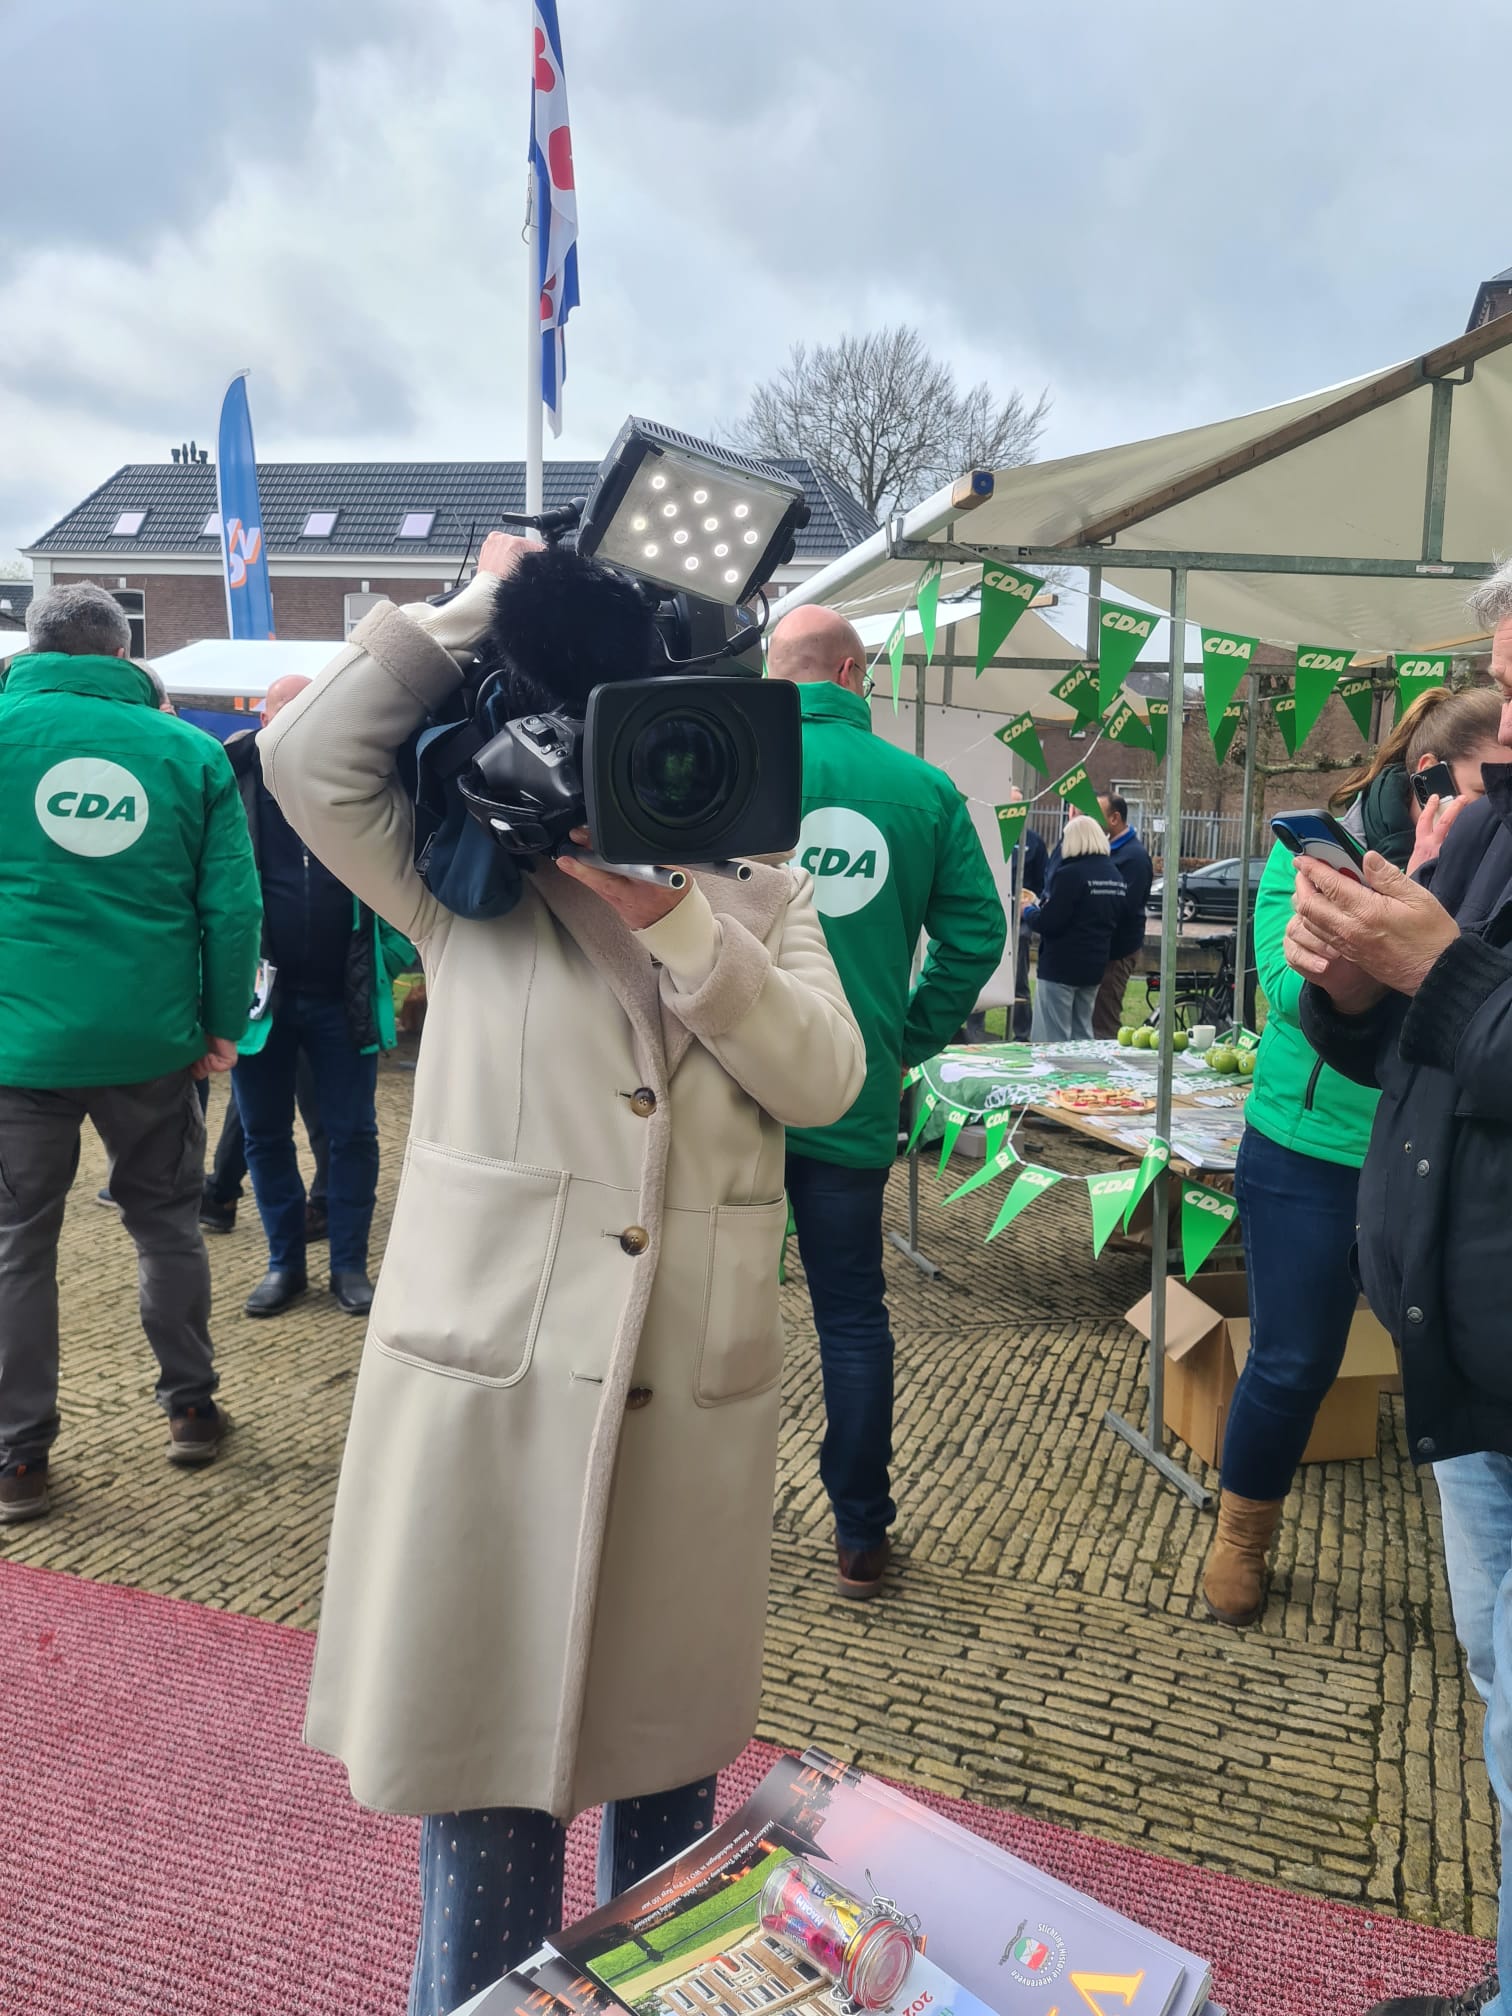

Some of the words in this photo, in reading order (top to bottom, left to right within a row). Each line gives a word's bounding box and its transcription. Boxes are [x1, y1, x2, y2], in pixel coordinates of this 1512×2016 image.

[984, 571, 1034, 601] CDA
[1102, 611, 1151, 638] CDA
[1203, 637, 1251, 659] CDA
[1298, 653, 1347, 672] CDA
[1400, 661, 1445, 677] CDA
[1059, 670, 1085, 698] CDA
[1342, 679, 1373, 697] CDA
[1150, 703, 1168, 714] CD
[1276, 699, 1295, 712] CD
[1003, 718, 1033, 743] CDA
[1109, 706, 1133, 739] CDA
[1059, 769, 1087, 796] CDA
[46, 791, 136, 822] CDA
[998, 805, 1027, 819] CDA
[801, 847, 876, 878] CDA
[986, 1110, 1009, 1128] CDA
[1019, 1171, 1054, 1187] CDA
[1092, 1178, 1136, 1195] CDA
[1184, 1190, 1236, 1220] CDA
[1037, 1922, 1064, 1949] Stichting
[1052, 1948, 1068, 1979] Historie
[1011, 1969, 1053, 1987] Heerenveen
